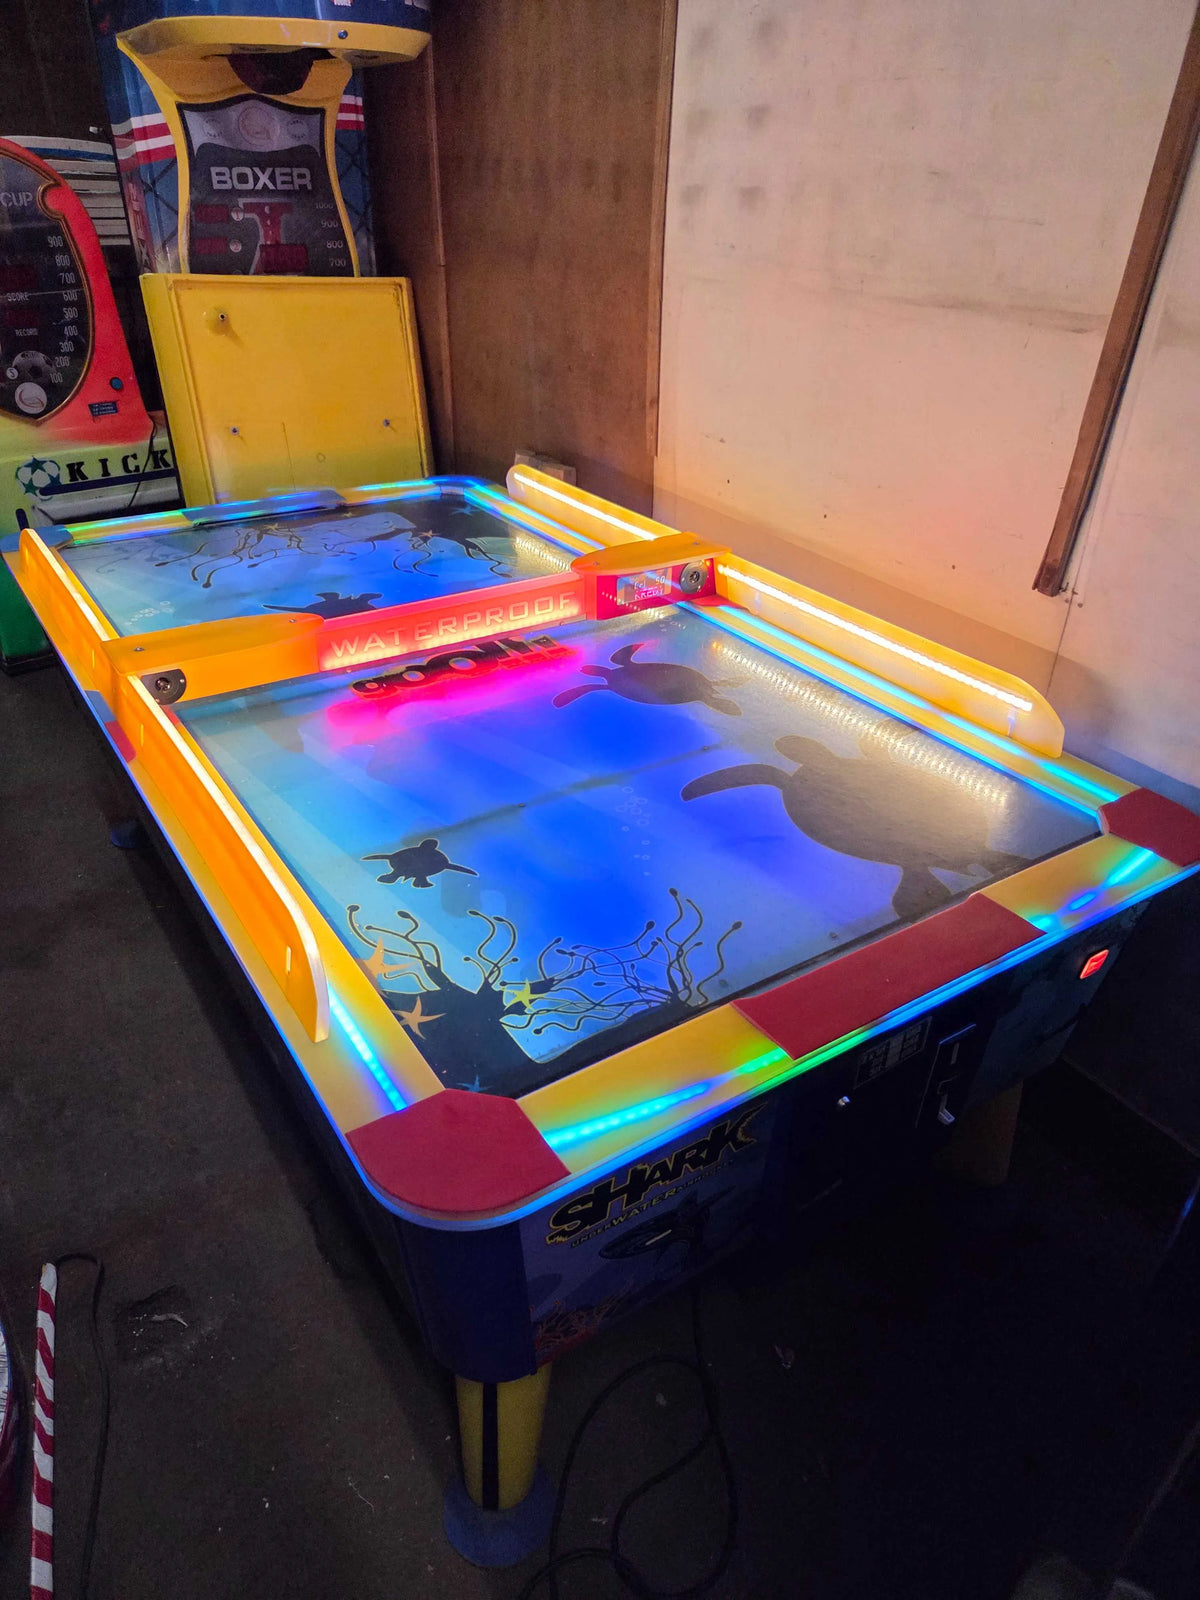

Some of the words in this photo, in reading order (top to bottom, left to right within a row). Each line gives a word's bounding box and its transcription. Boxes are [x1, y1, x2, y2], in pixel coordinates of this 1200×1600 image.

[210, 166, 312, 190] BOXER
[0, 192, 33, 207] CUP
[321, 220, 339, 229] 900
[47, 236, 64, 248] 900
[326, 239, 344, 249] 800
[55, 254, 71, 267] 800
[328, 258, 347, 267] 700
[60, 272, 76, 285] 700
[7, 291, 29, 302] SCORE
[63, 290, 78, 301] 600
[63, 306, 79, 319] 500
[64, 325, 79, 337] 400
[60, 341, 75, 353] 300
[55, 356, 70, 368] 200
[50, 372, 63, 384] 100
[66, 448, 171, 483] KICK
[331, 591, 577, 658] WATERPROOF
[545, 1101, 768, 1246] SHARK
